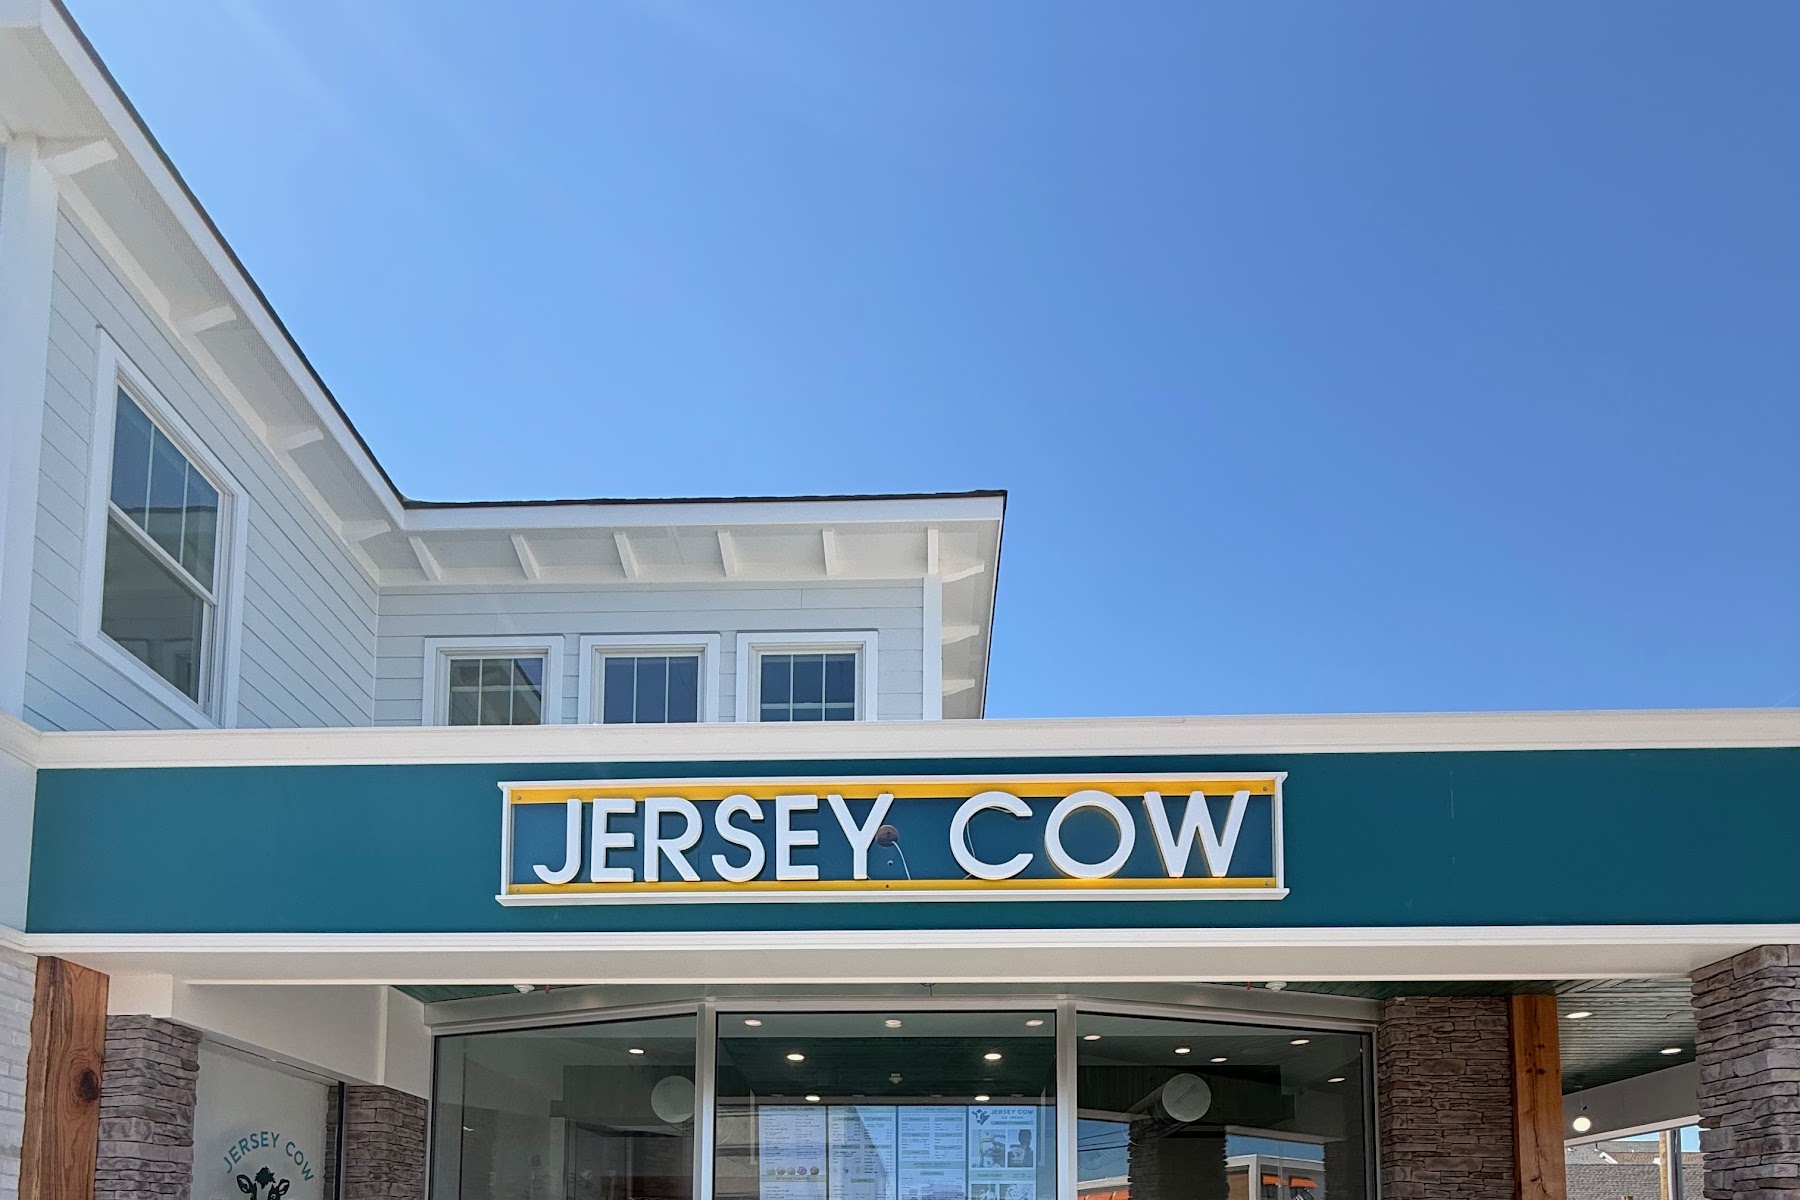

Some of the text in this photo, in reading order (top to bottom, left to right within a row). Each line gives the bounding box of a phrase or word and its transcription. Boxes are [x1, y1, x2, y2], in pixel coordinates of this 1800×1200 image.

[533, 790, 1250, 884] JERSEY COW
[223, 1131, 314, 1182] JERSEY COW
